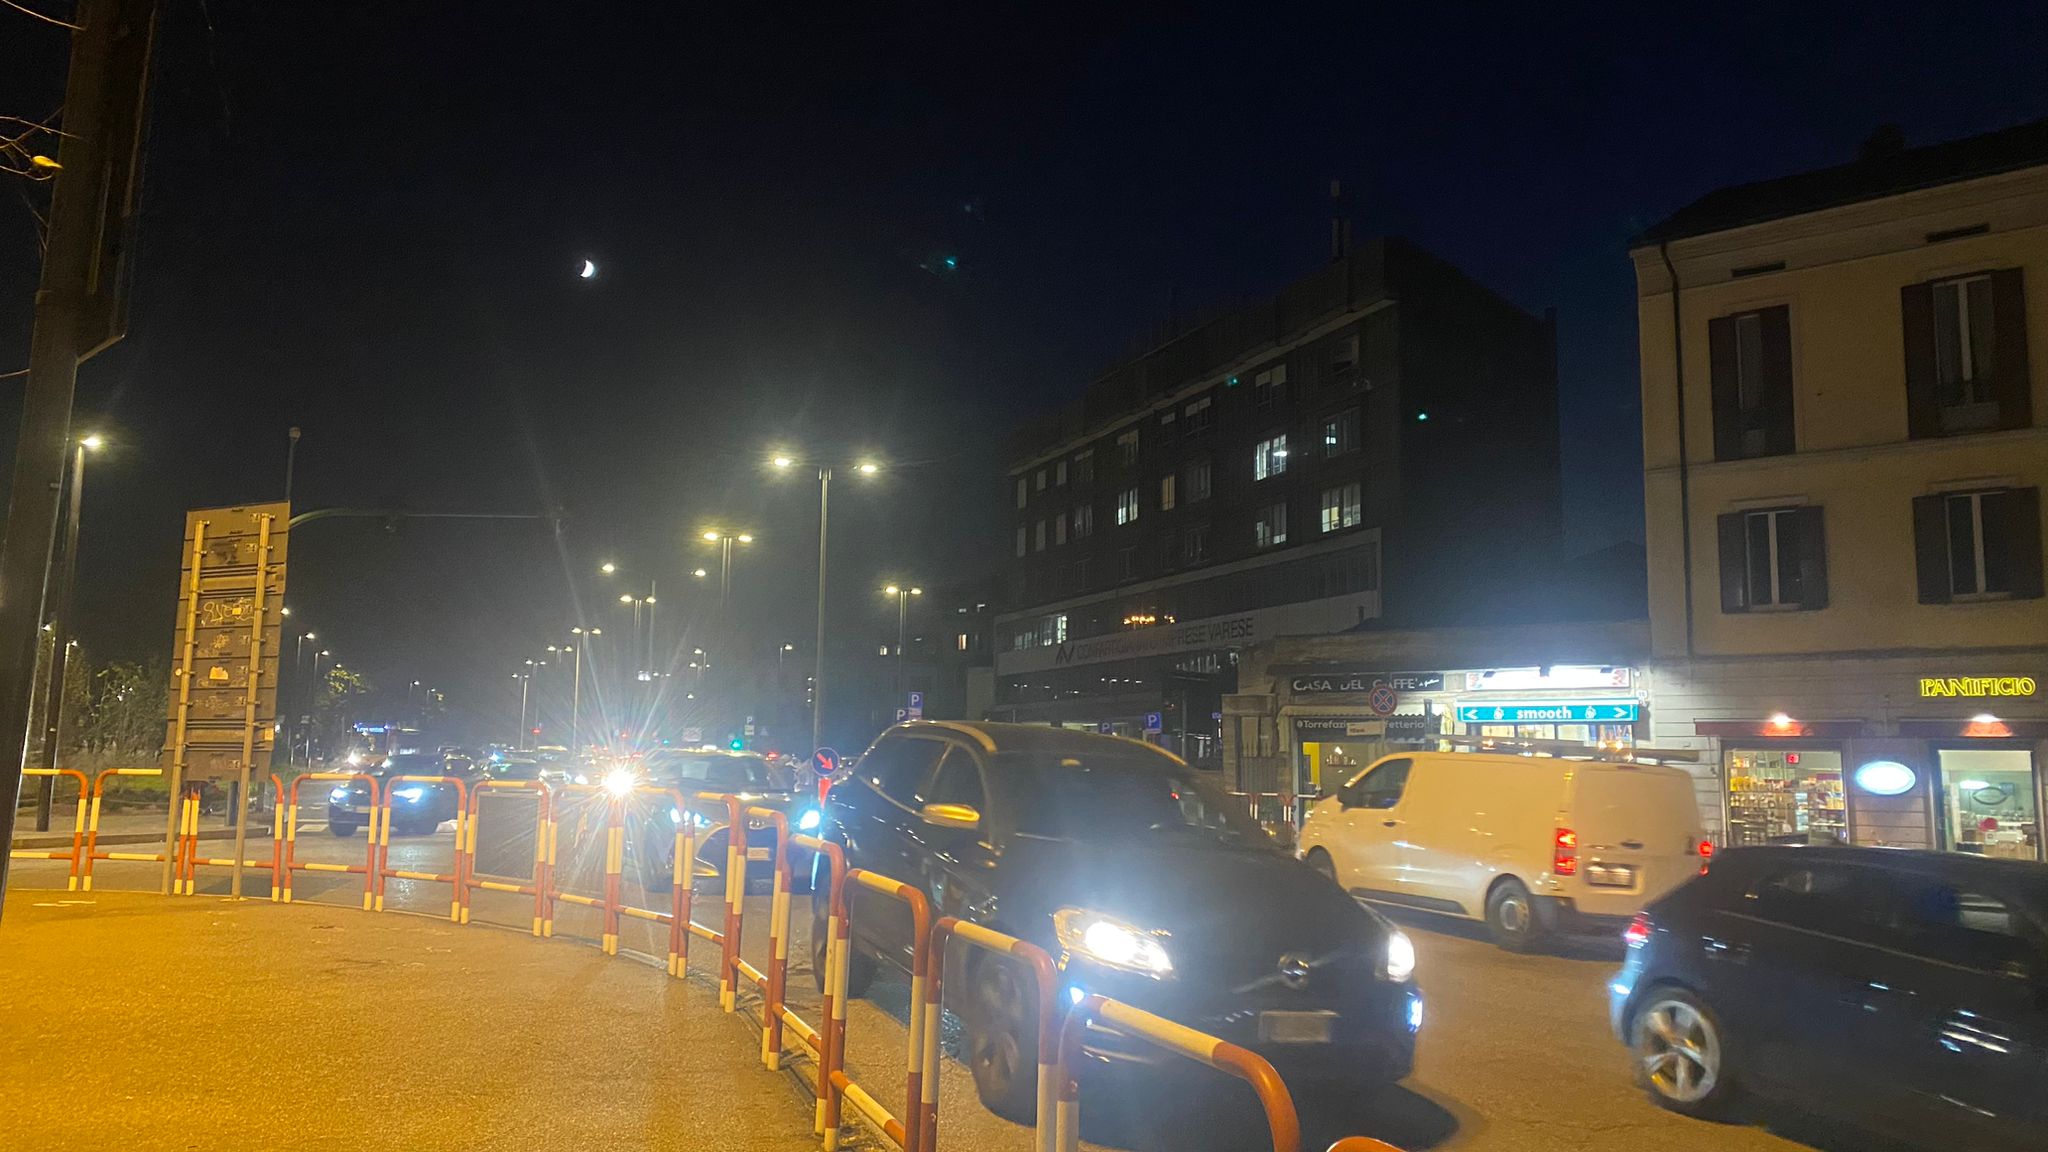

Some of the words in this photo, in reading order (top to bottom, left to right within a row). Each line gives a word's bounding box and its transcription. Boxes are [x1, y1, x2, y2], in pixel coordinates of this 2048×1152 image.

[1208, 617, 1254, 641] VARESE
[1293, 680, 1332, 691] CASA
[1920, 677, 2036, 697] PANIFICIO
[911, 694, 920, 706] P
[896, 709, 906, 721] P
[1516, 706, 1572, 720] smooth
[1147, 714, 1158, 727] P
[1303, 720, 1347, 729] Torrefazi
[1101, 722, 1111, 733] P
